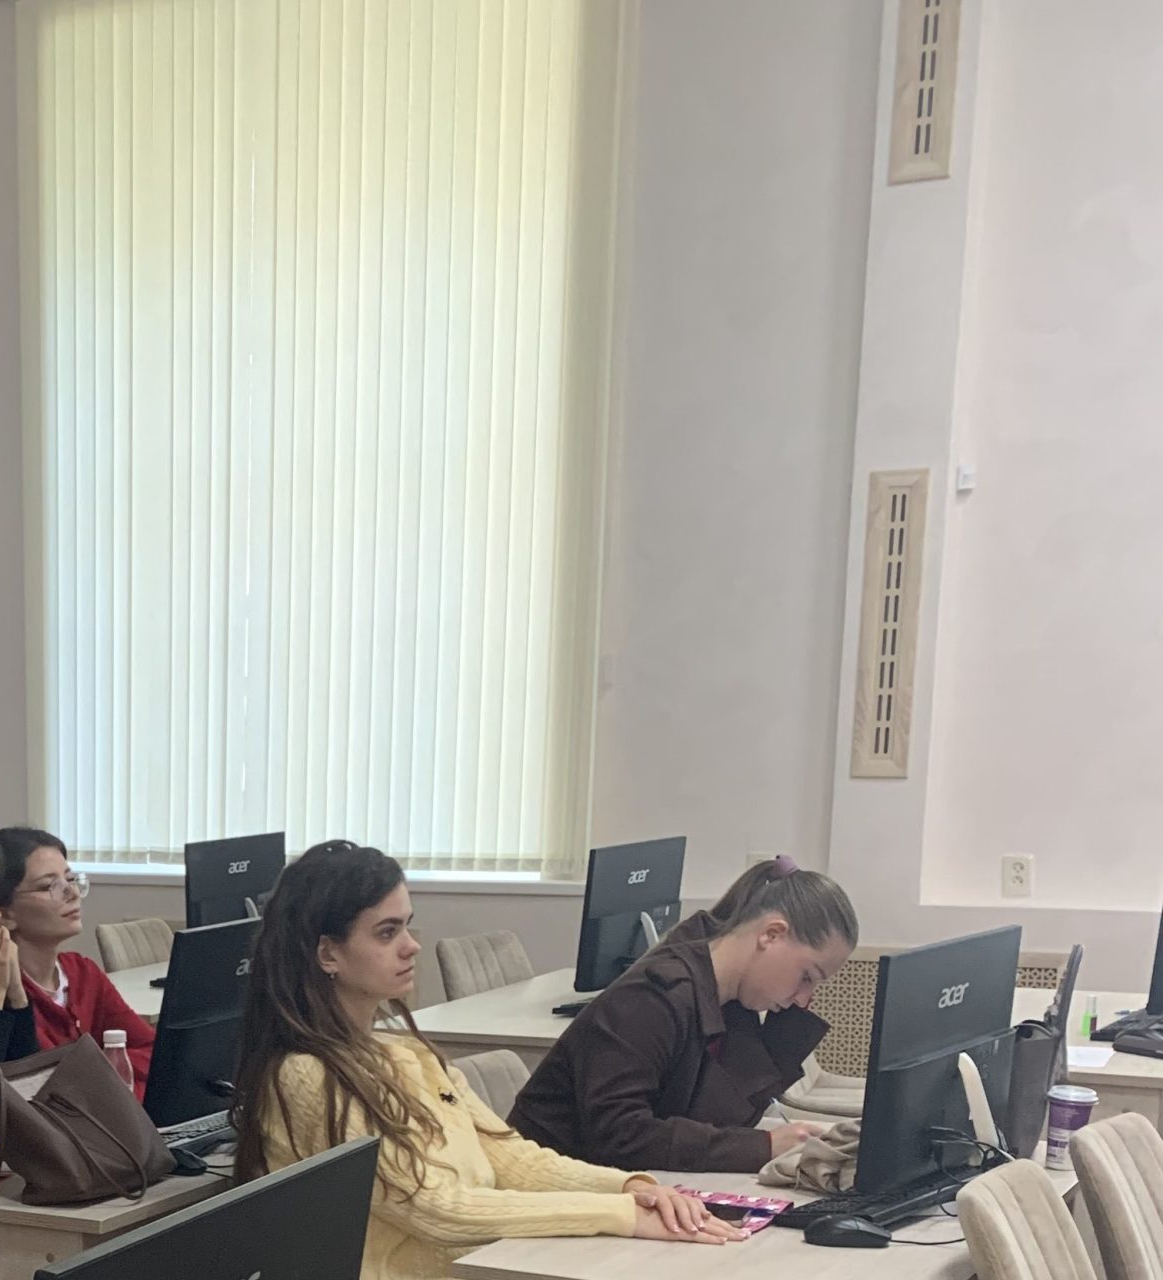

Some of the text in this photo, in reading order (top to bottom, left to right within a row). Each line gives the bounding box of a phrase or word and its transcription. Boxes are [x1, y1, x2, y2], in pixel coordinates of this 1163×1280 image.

[228, 860, 251, 874] acer
[628, 869, 650, 884] acer
[938, 982, 969, 1009] acer
